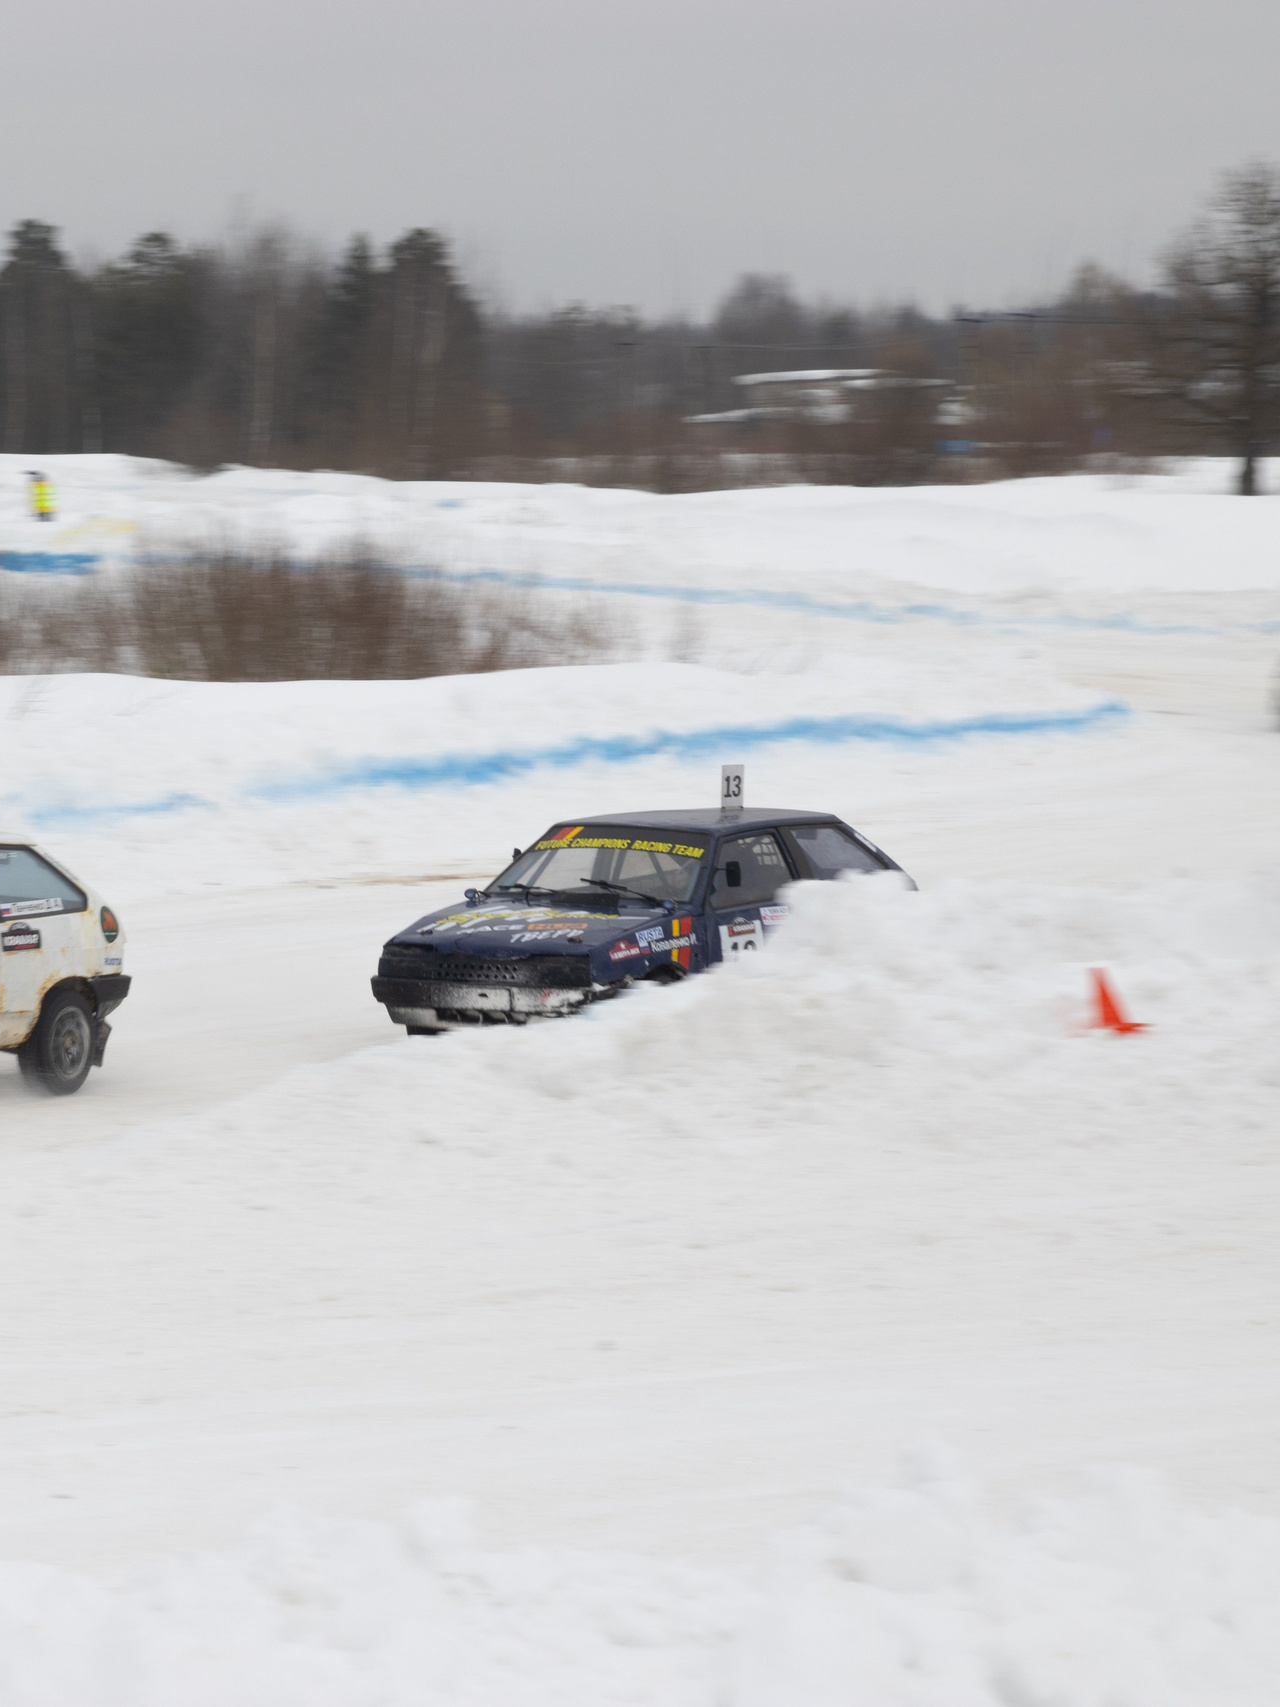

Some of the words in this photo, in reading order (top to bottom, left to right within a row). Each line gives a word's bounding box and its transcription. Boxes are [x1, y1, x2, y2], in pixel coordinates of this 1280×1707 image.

[723, 774, 742, 798] 13
[535, 839, 572, 851] FUTURE
[571, 837, 631, 850] CHAMPIONS
[631, 839, 672, 853] RACING
[671, 844, 705, 859] TEAM
